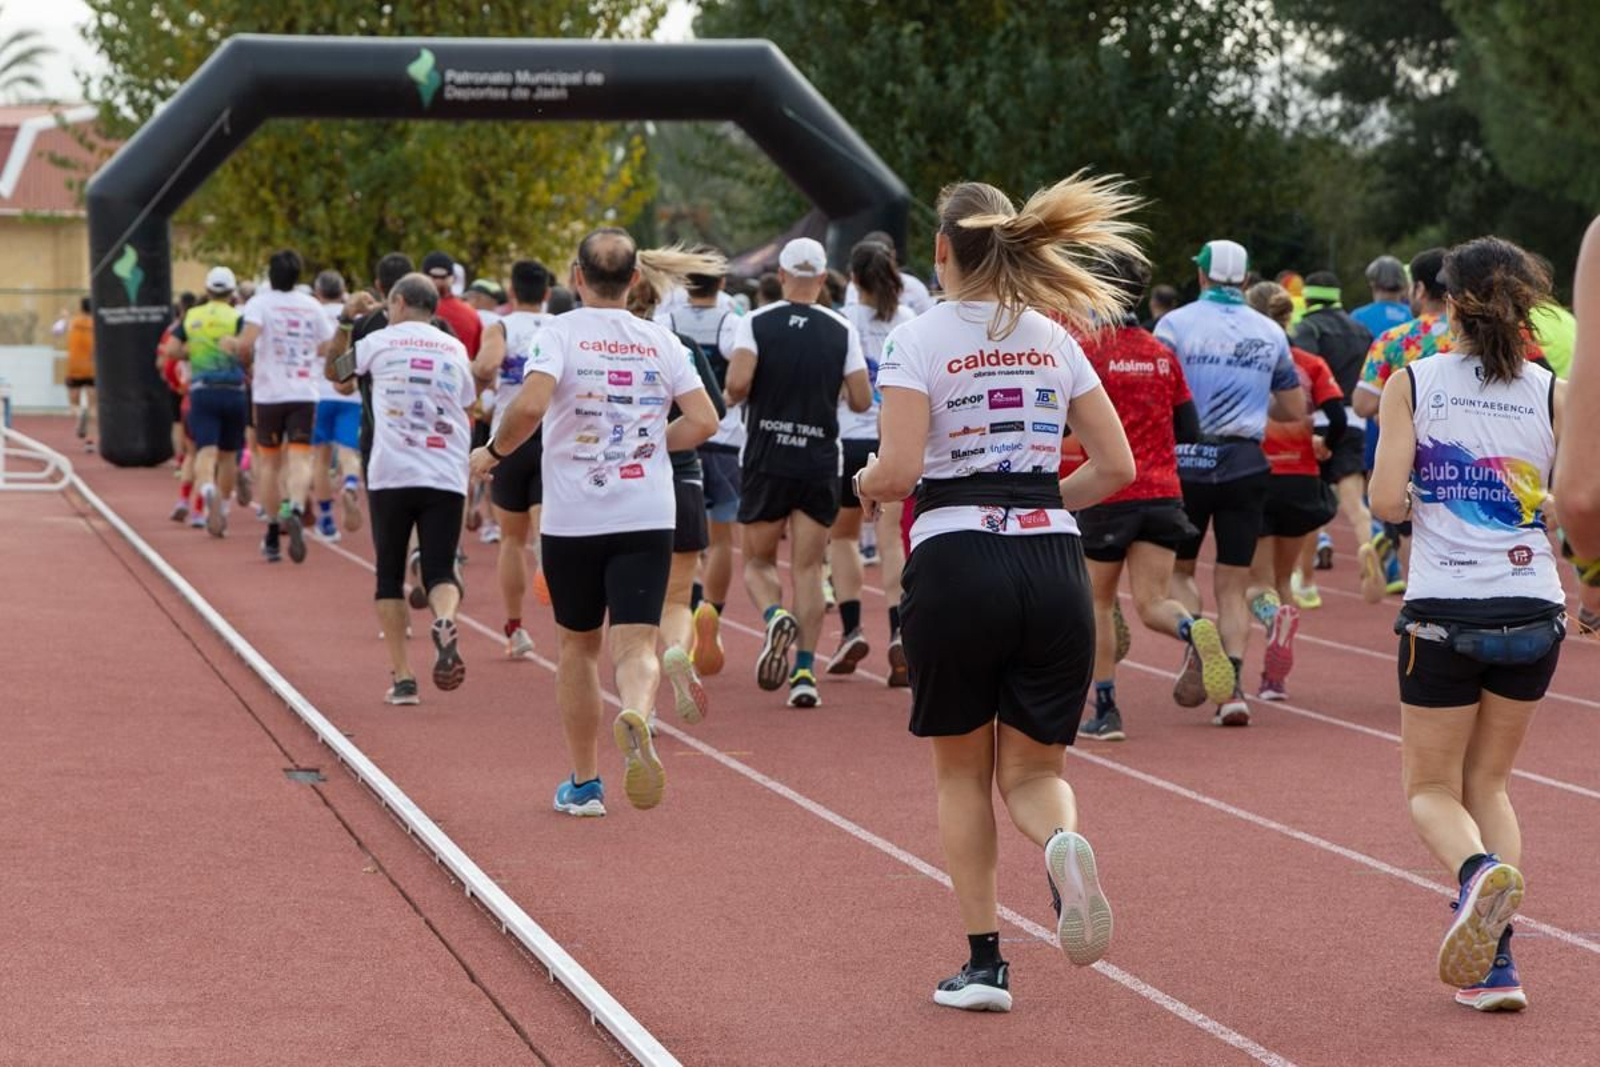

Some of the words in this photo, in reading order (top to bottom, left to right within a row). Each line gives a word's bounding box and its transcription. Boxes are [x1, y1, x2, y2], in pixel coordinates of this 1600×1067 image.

[445, 69, 513, 84] Patronato
[515, 70, 583, 85] Municipal
[585, 72, 605, 84] de
[444, 85, 508, 100] Deportes
[511, 87, 530, 99] de
[946, 349, 1056, 375] calderón
[1109, 359, 1154, 372] Adalmo
[998, 369, 1035, 377] maestras
[1450, 396, 1536, 416] QUINTAESENCIA
[796, 424, 825, 438] TRAIL
[776, 433, 808, 447] TEAM
[951, 447, 986, 460] Blanca
[1420, 462, 1459, 481] club
[1436, 483, 1519, 503] entrénate
